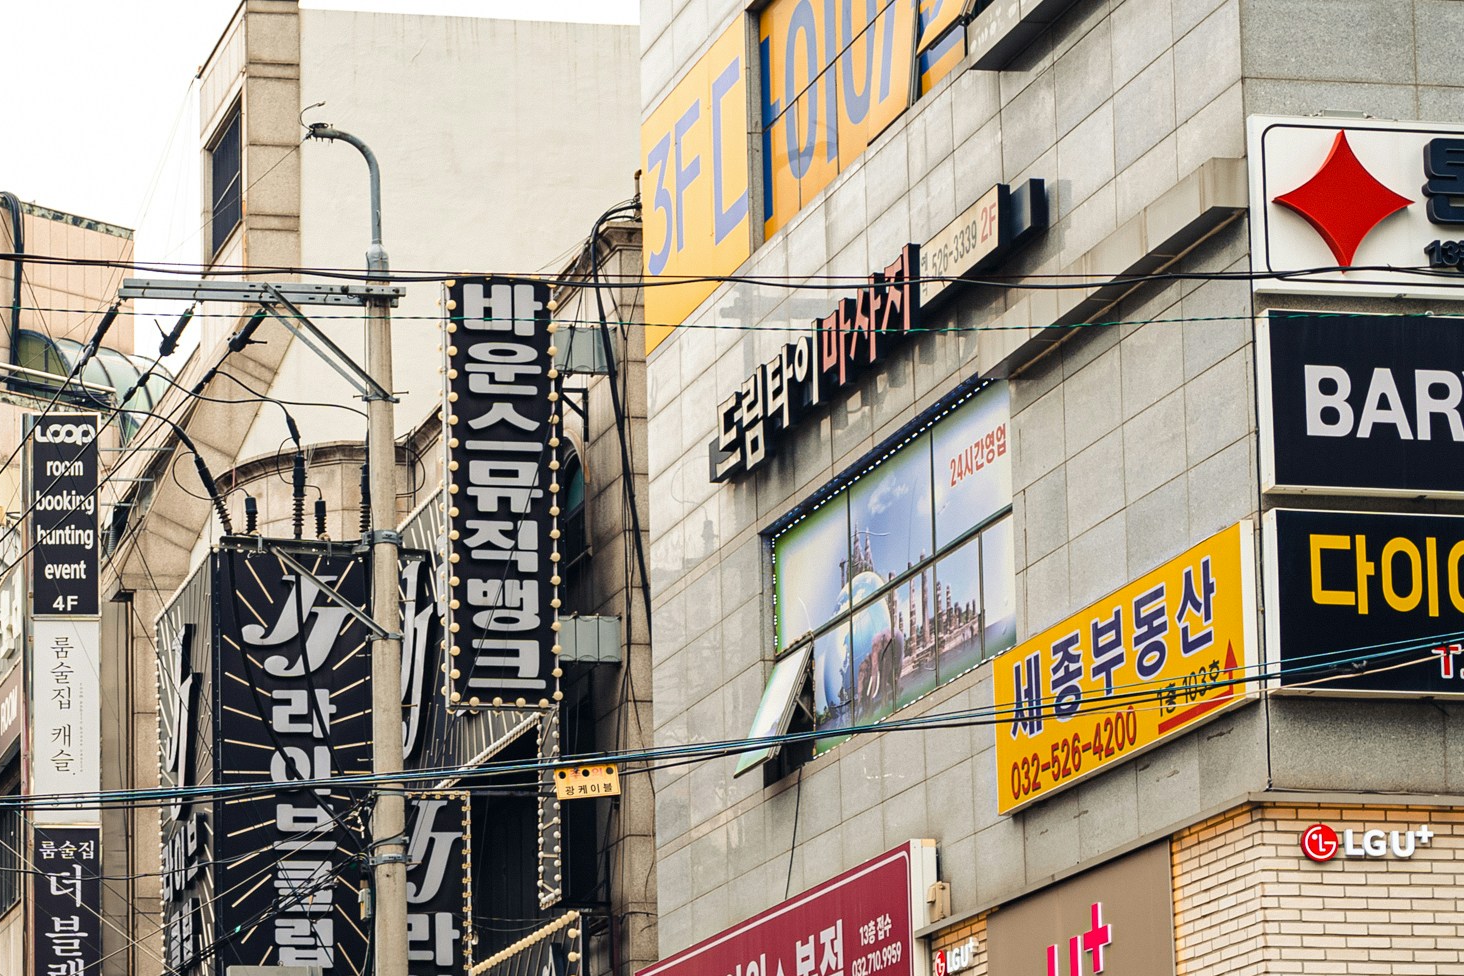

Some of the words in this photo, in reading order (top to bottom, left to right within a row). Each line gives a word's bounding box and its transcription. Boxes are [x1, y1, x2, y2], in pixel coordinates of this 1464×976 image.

[980, 202, 997, 245] 2F
[34, 423, 95, 445] LOOP
[950, 421, 1008, 487] 24시간영업
[46, 459, 84, 477] room
[36, 489, 95, 513] booking
[36, 524, 94, 549] hunting
[44, 560, 87, 580] event
[53, 595, 79, 611] 4F
[1011, 556, 1216, 741] 세종부동산
[51, 636, 75, 710] 룸술집
[1011, 704, 1138, 801] 032-526-4200
[565, 782, 613, 796] 광케이블
[39, 840, 95, 860] 룸술집
[859, 922, 876, 947] 13층
[876, 913, 892, 938] 접수
